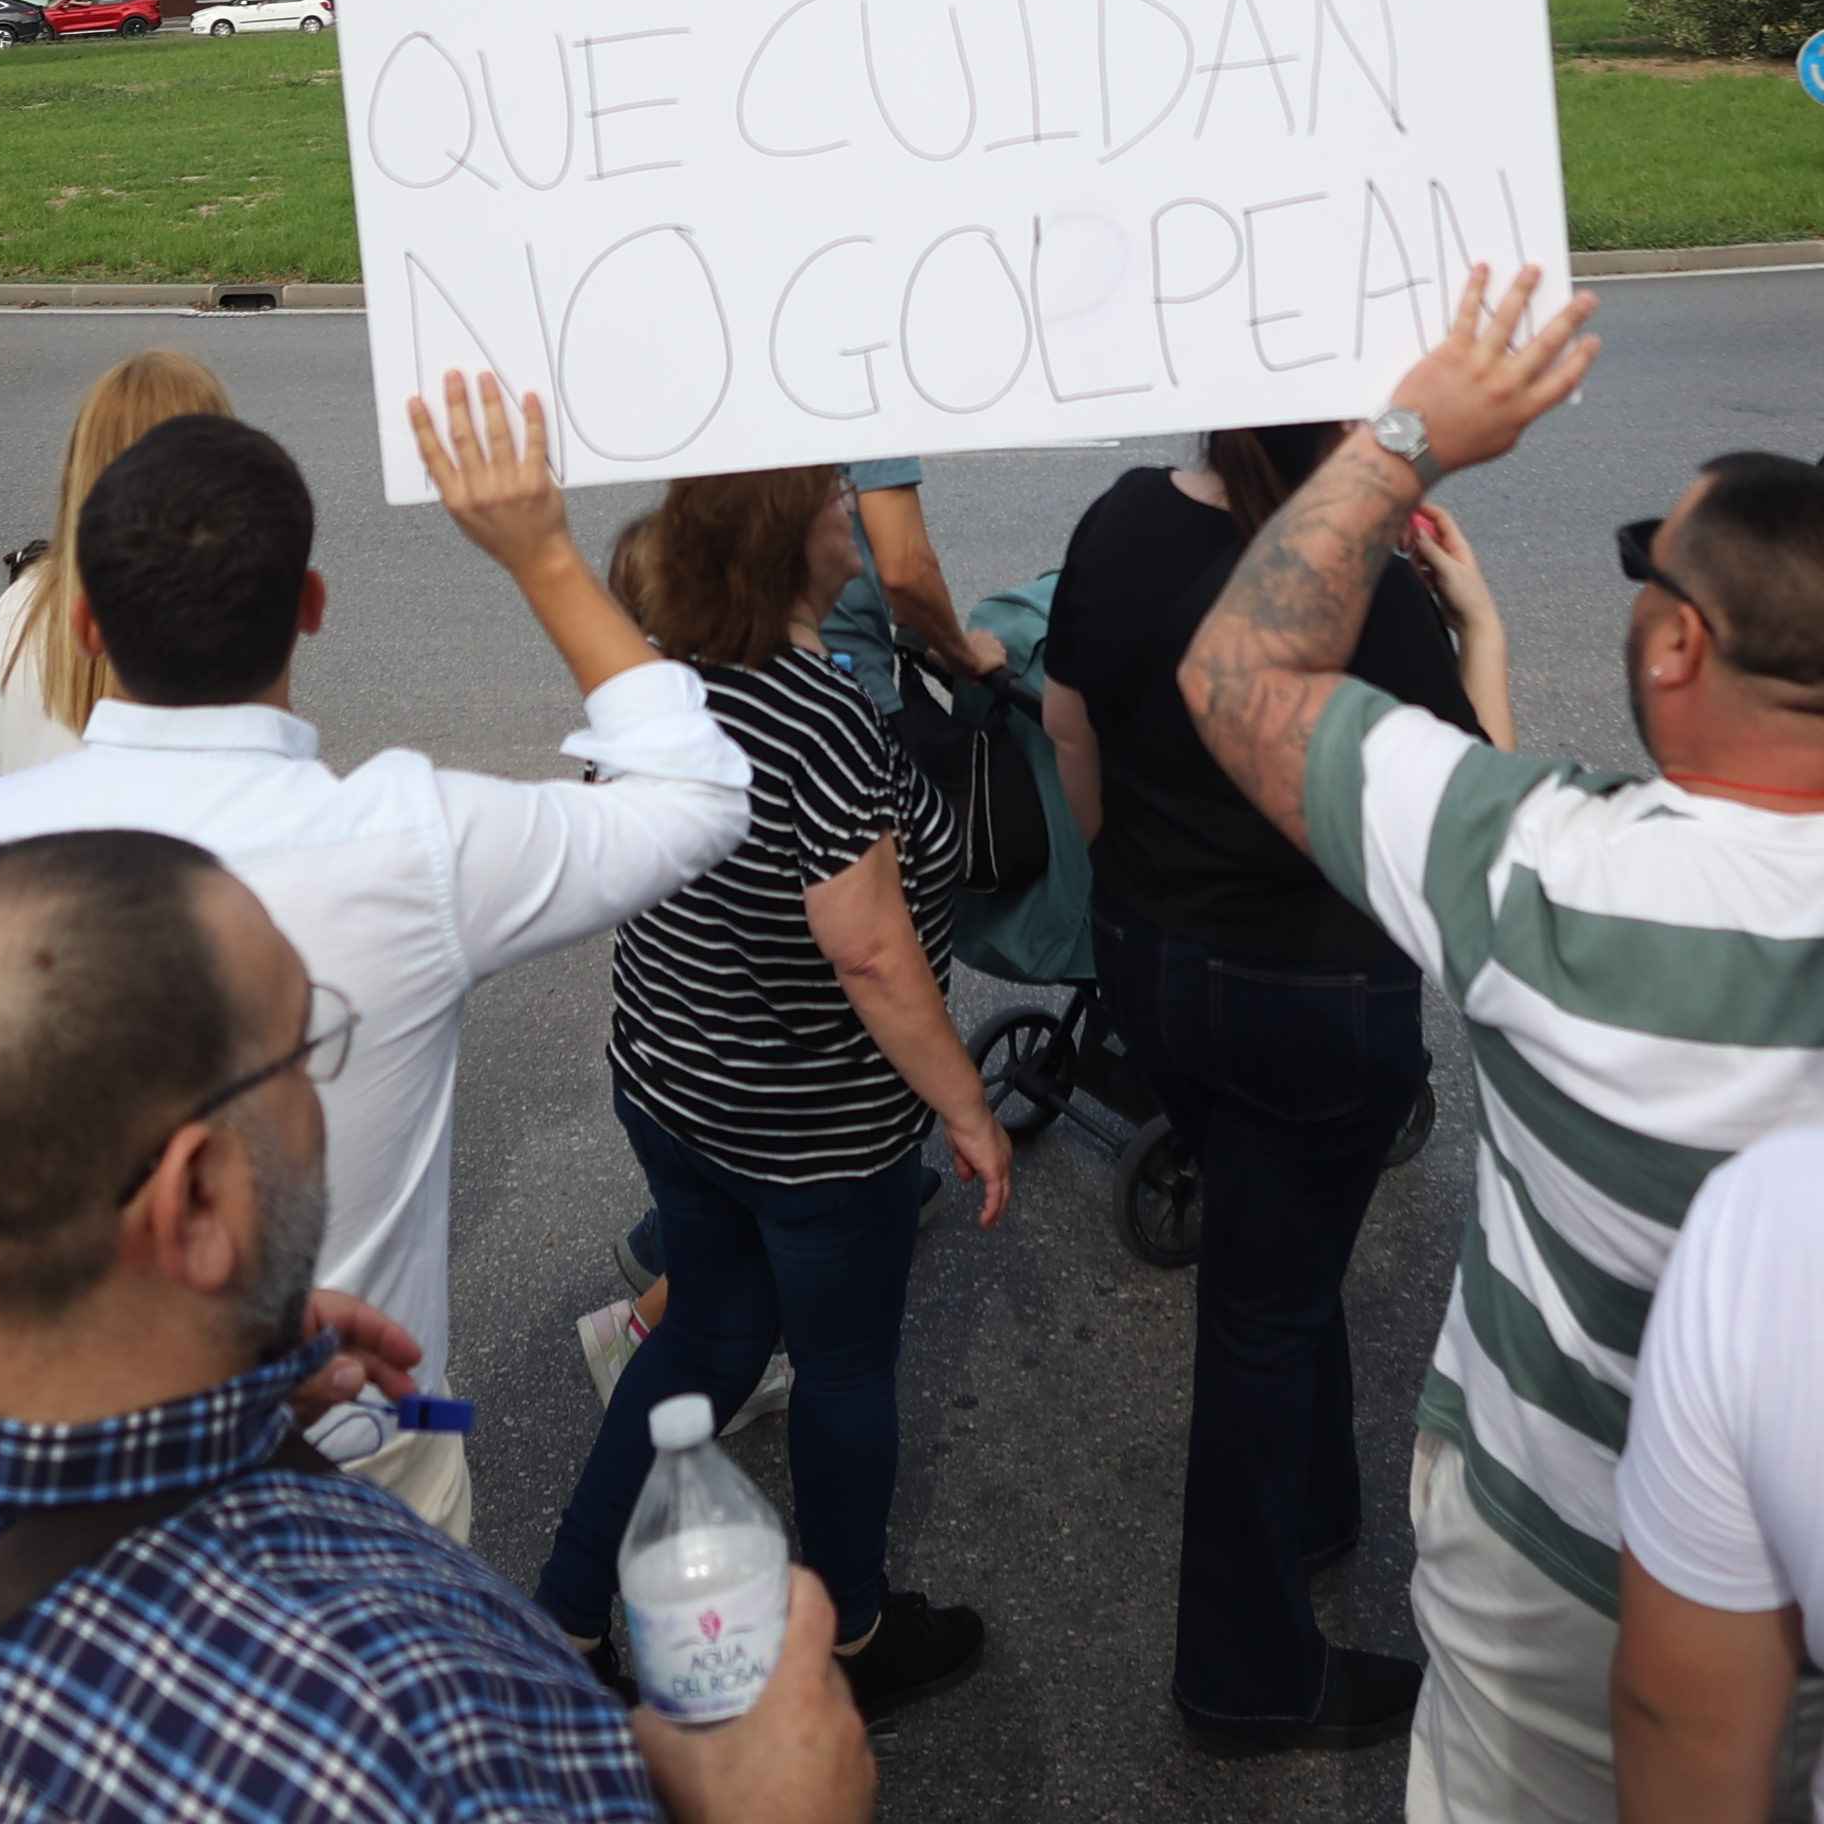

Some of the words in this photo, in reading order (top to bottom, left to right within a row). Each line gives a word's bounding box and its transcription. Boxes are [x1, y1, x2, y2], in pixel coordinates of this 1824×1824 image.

[366, 24, 693, 191] QUE
[402, 222, 733, 492] NO
[768, 168, 1536, 422] GOLPEAN
[689, 1645, 747, 1674] AGUA
